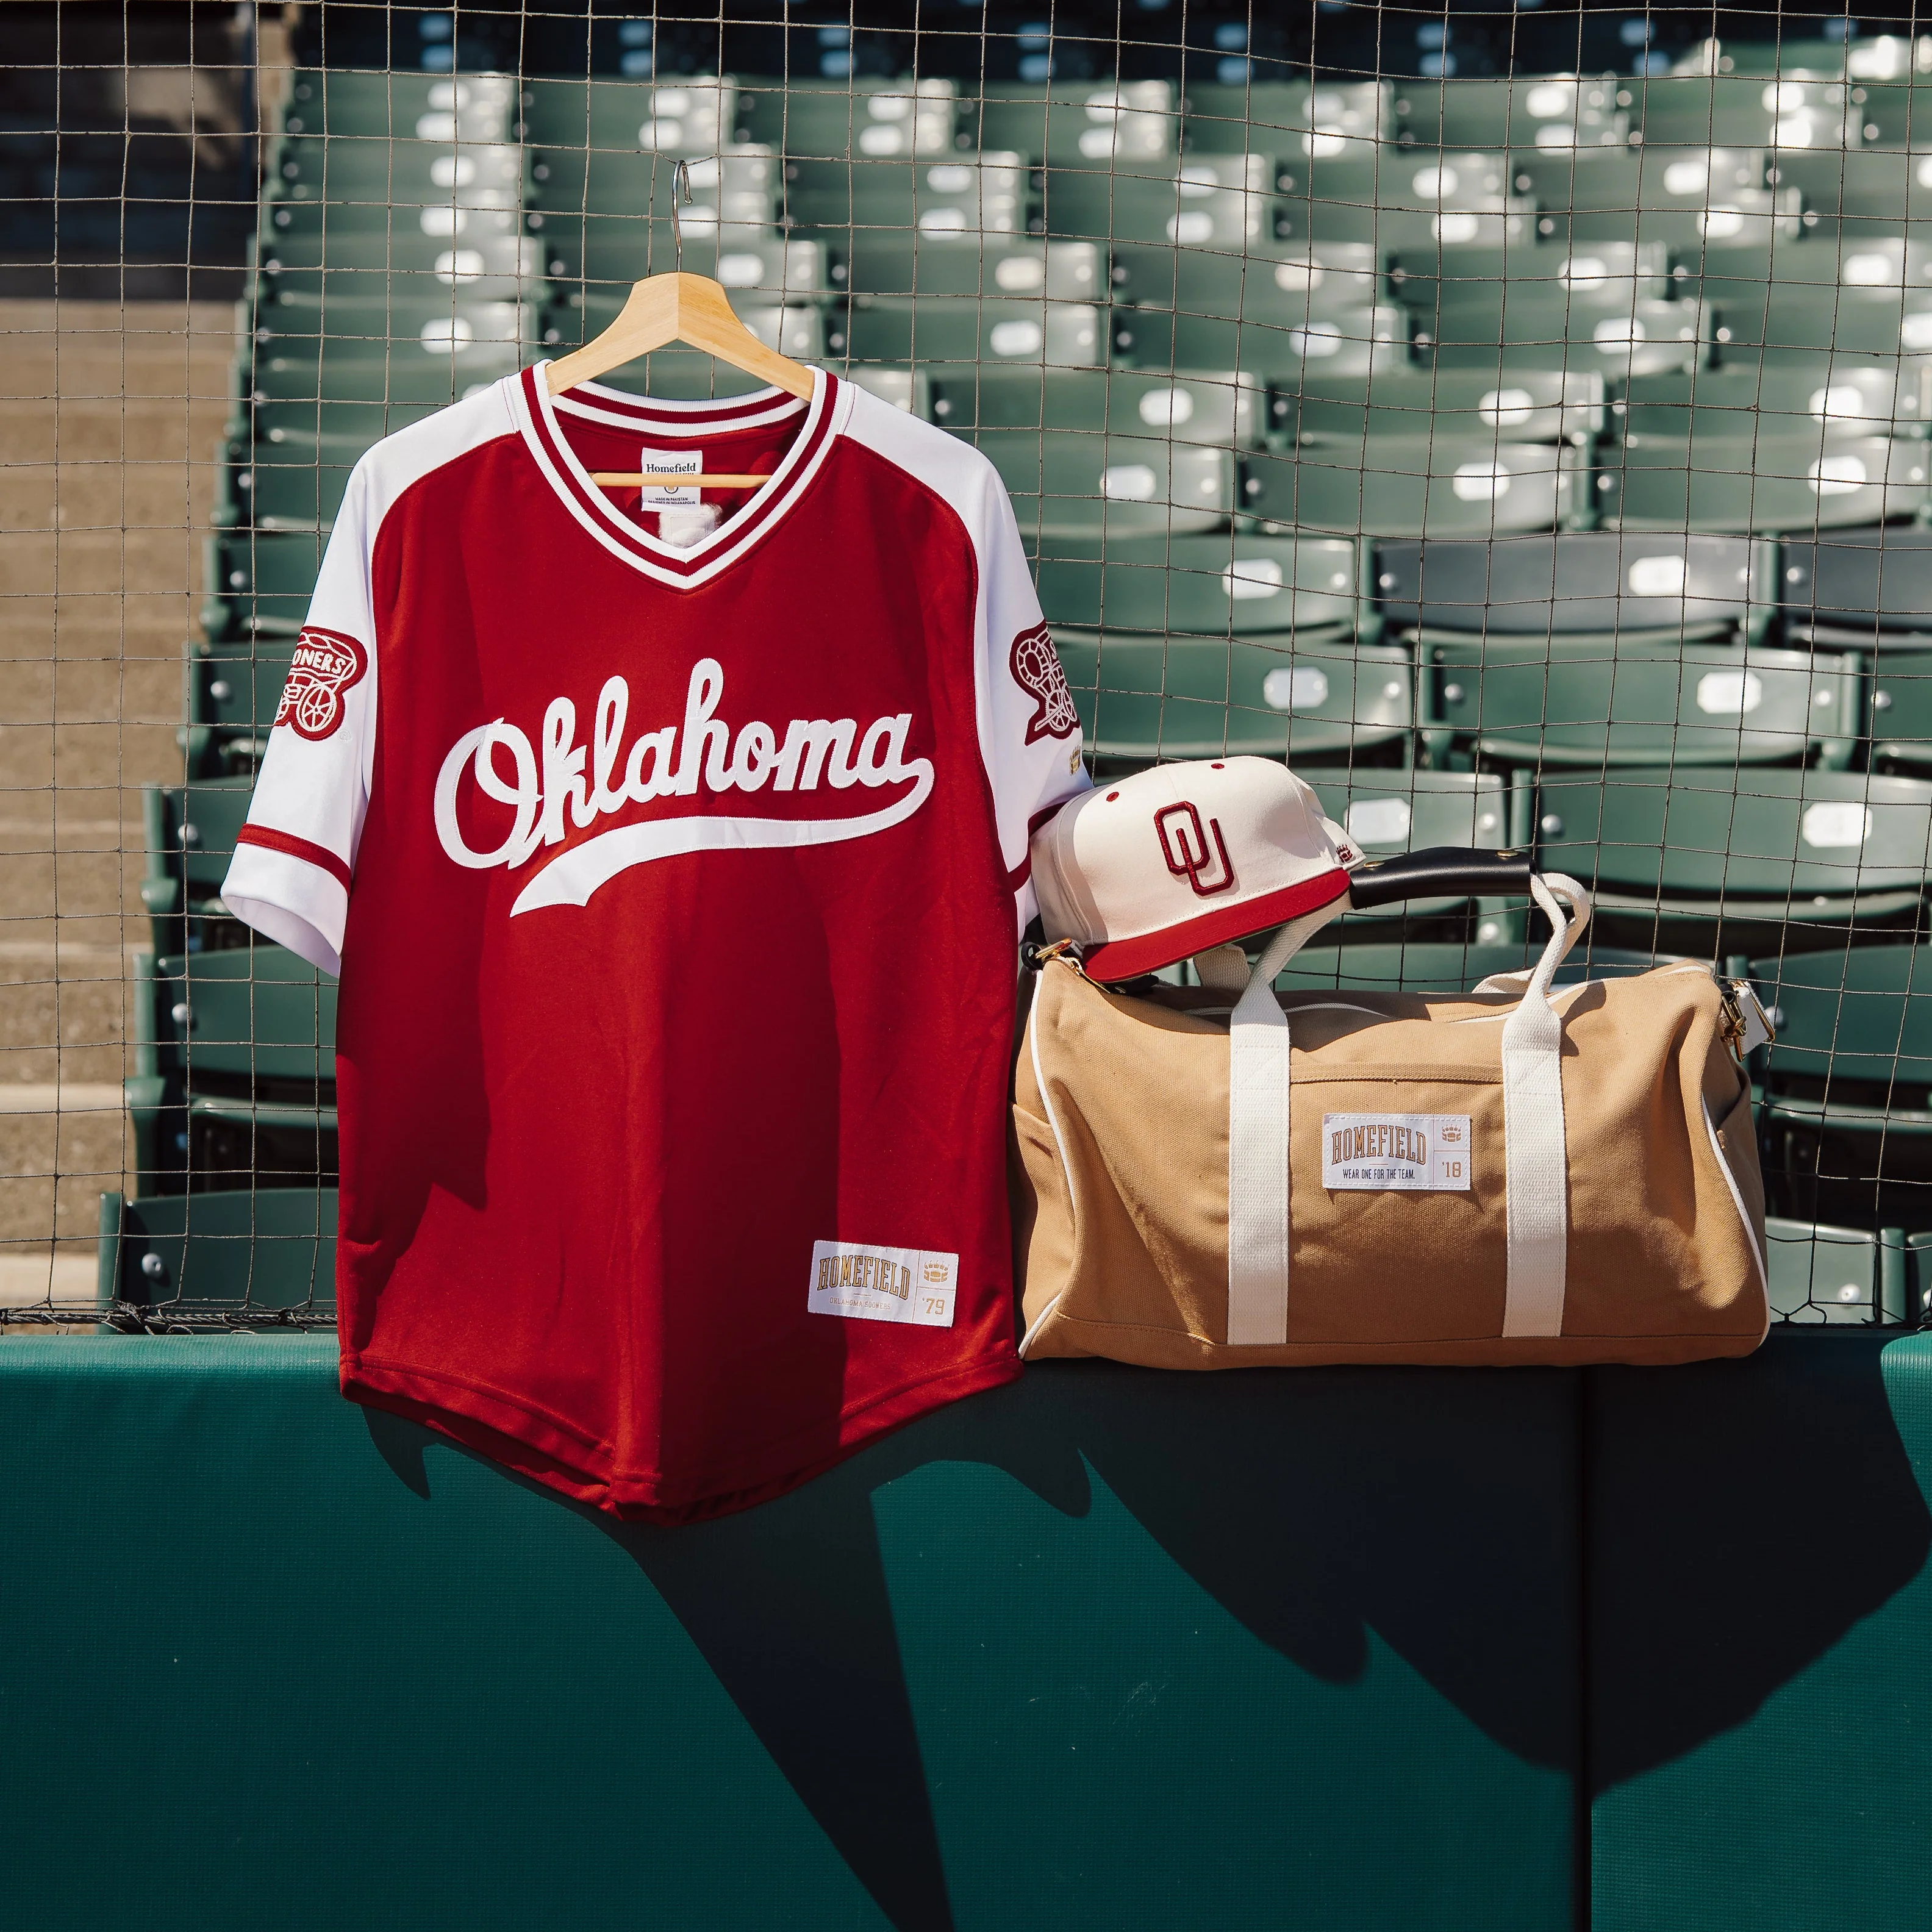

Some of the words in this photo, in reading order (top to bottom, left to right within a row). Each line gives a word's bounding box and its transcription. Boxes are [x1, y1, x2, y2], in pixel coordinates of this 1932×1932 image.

[646, 463, 696, 473] Homefield
[434, 657, 935, 870] Oklahoma
[1154, 801, 1234, 896] OU
[1331, 1125, 1426, 1165] HOMEFIELD
[1343, 1168, 1359, 1179] WEAR
[1361, 1168, 1372, 1179] ONE
[1374, 1168, 1384, 1179] FOR
[1386, 1168, 1397, 1179] THE
[1398, 1168, 1415, 1179] TEAM.
[1442, 1162, 1461, 1178] '18
[817, 1254, 911, 1301] HOMEFIELD
[829, 1297, 863, 1307] OKLAHOMA
[864, 1301, 891, 1310] SOONERS
[921, 1297, 945, 1315] '79
